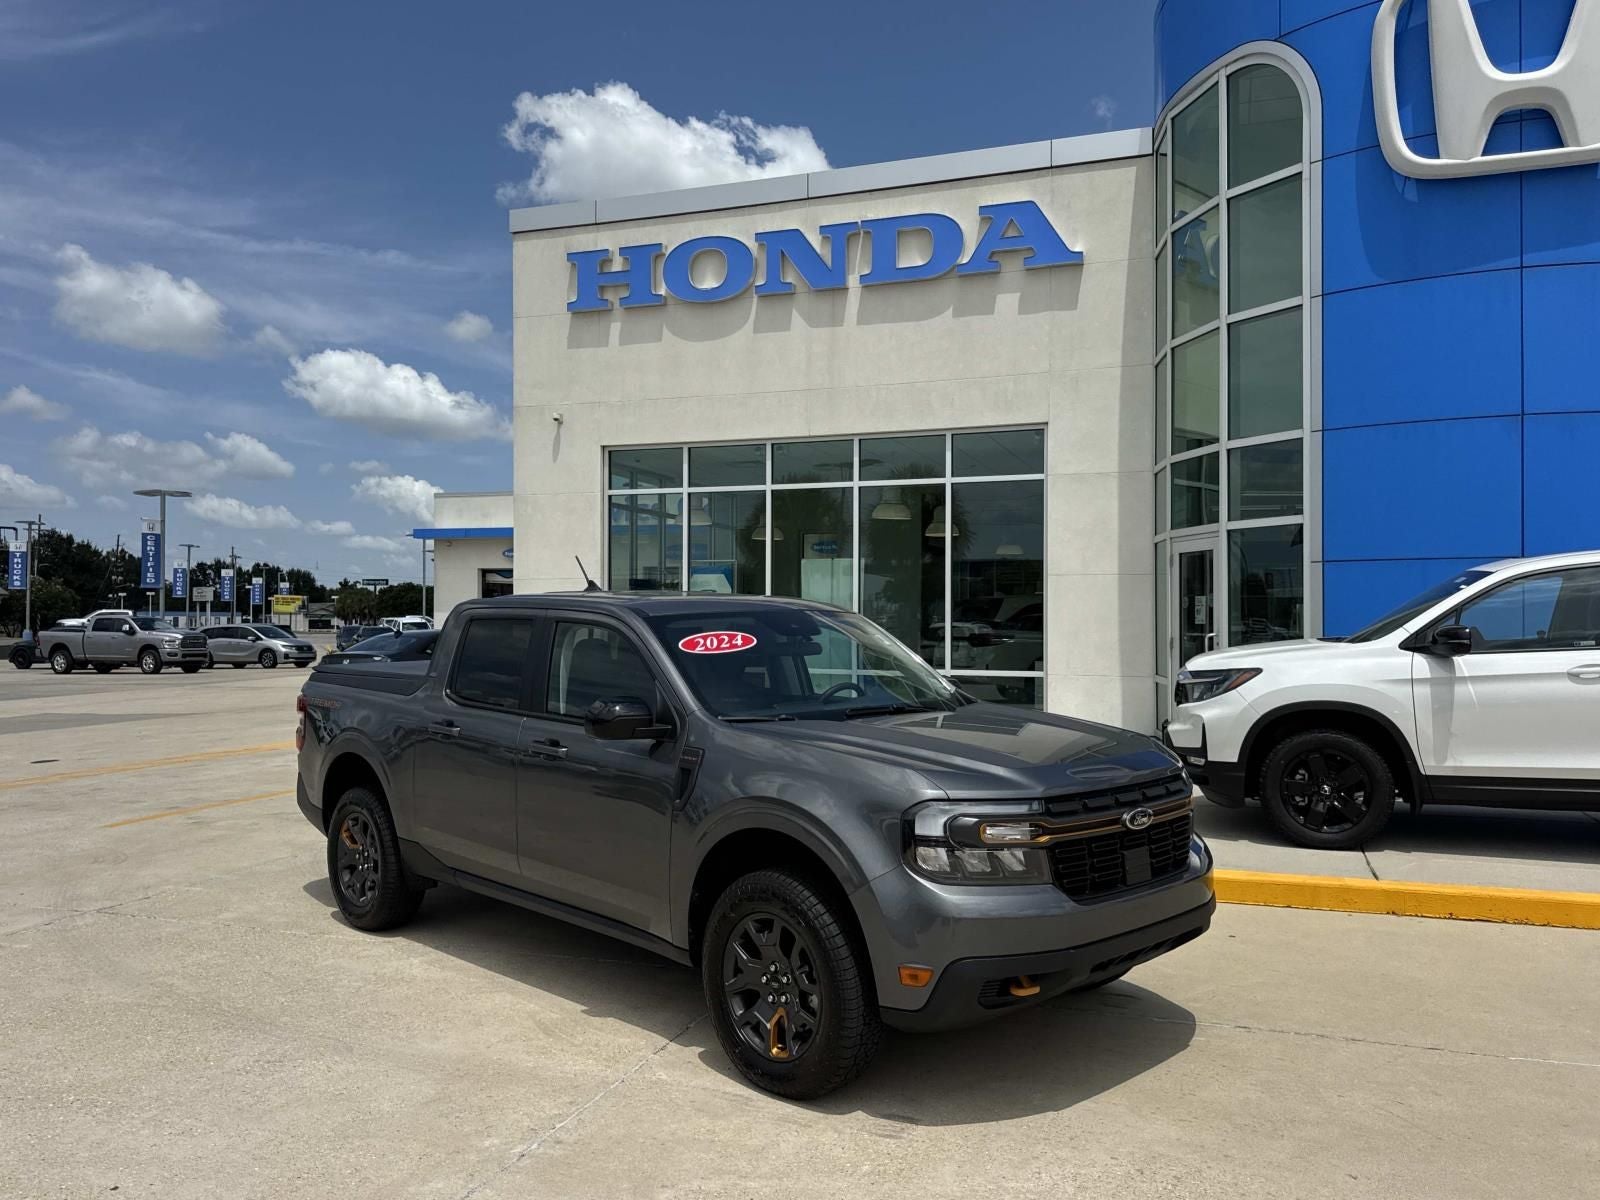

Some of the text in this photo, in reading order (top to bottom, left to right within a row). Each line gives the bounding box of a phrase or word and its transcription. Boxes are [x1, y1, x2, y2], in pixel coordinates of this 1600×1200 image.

[567, 200, 1084, 312] HONDA
[13, 552, 22, 587] TRUCKS
[146, 535, 156, 584] CERTIFIED
[694, 634, 743, 652] 2024
